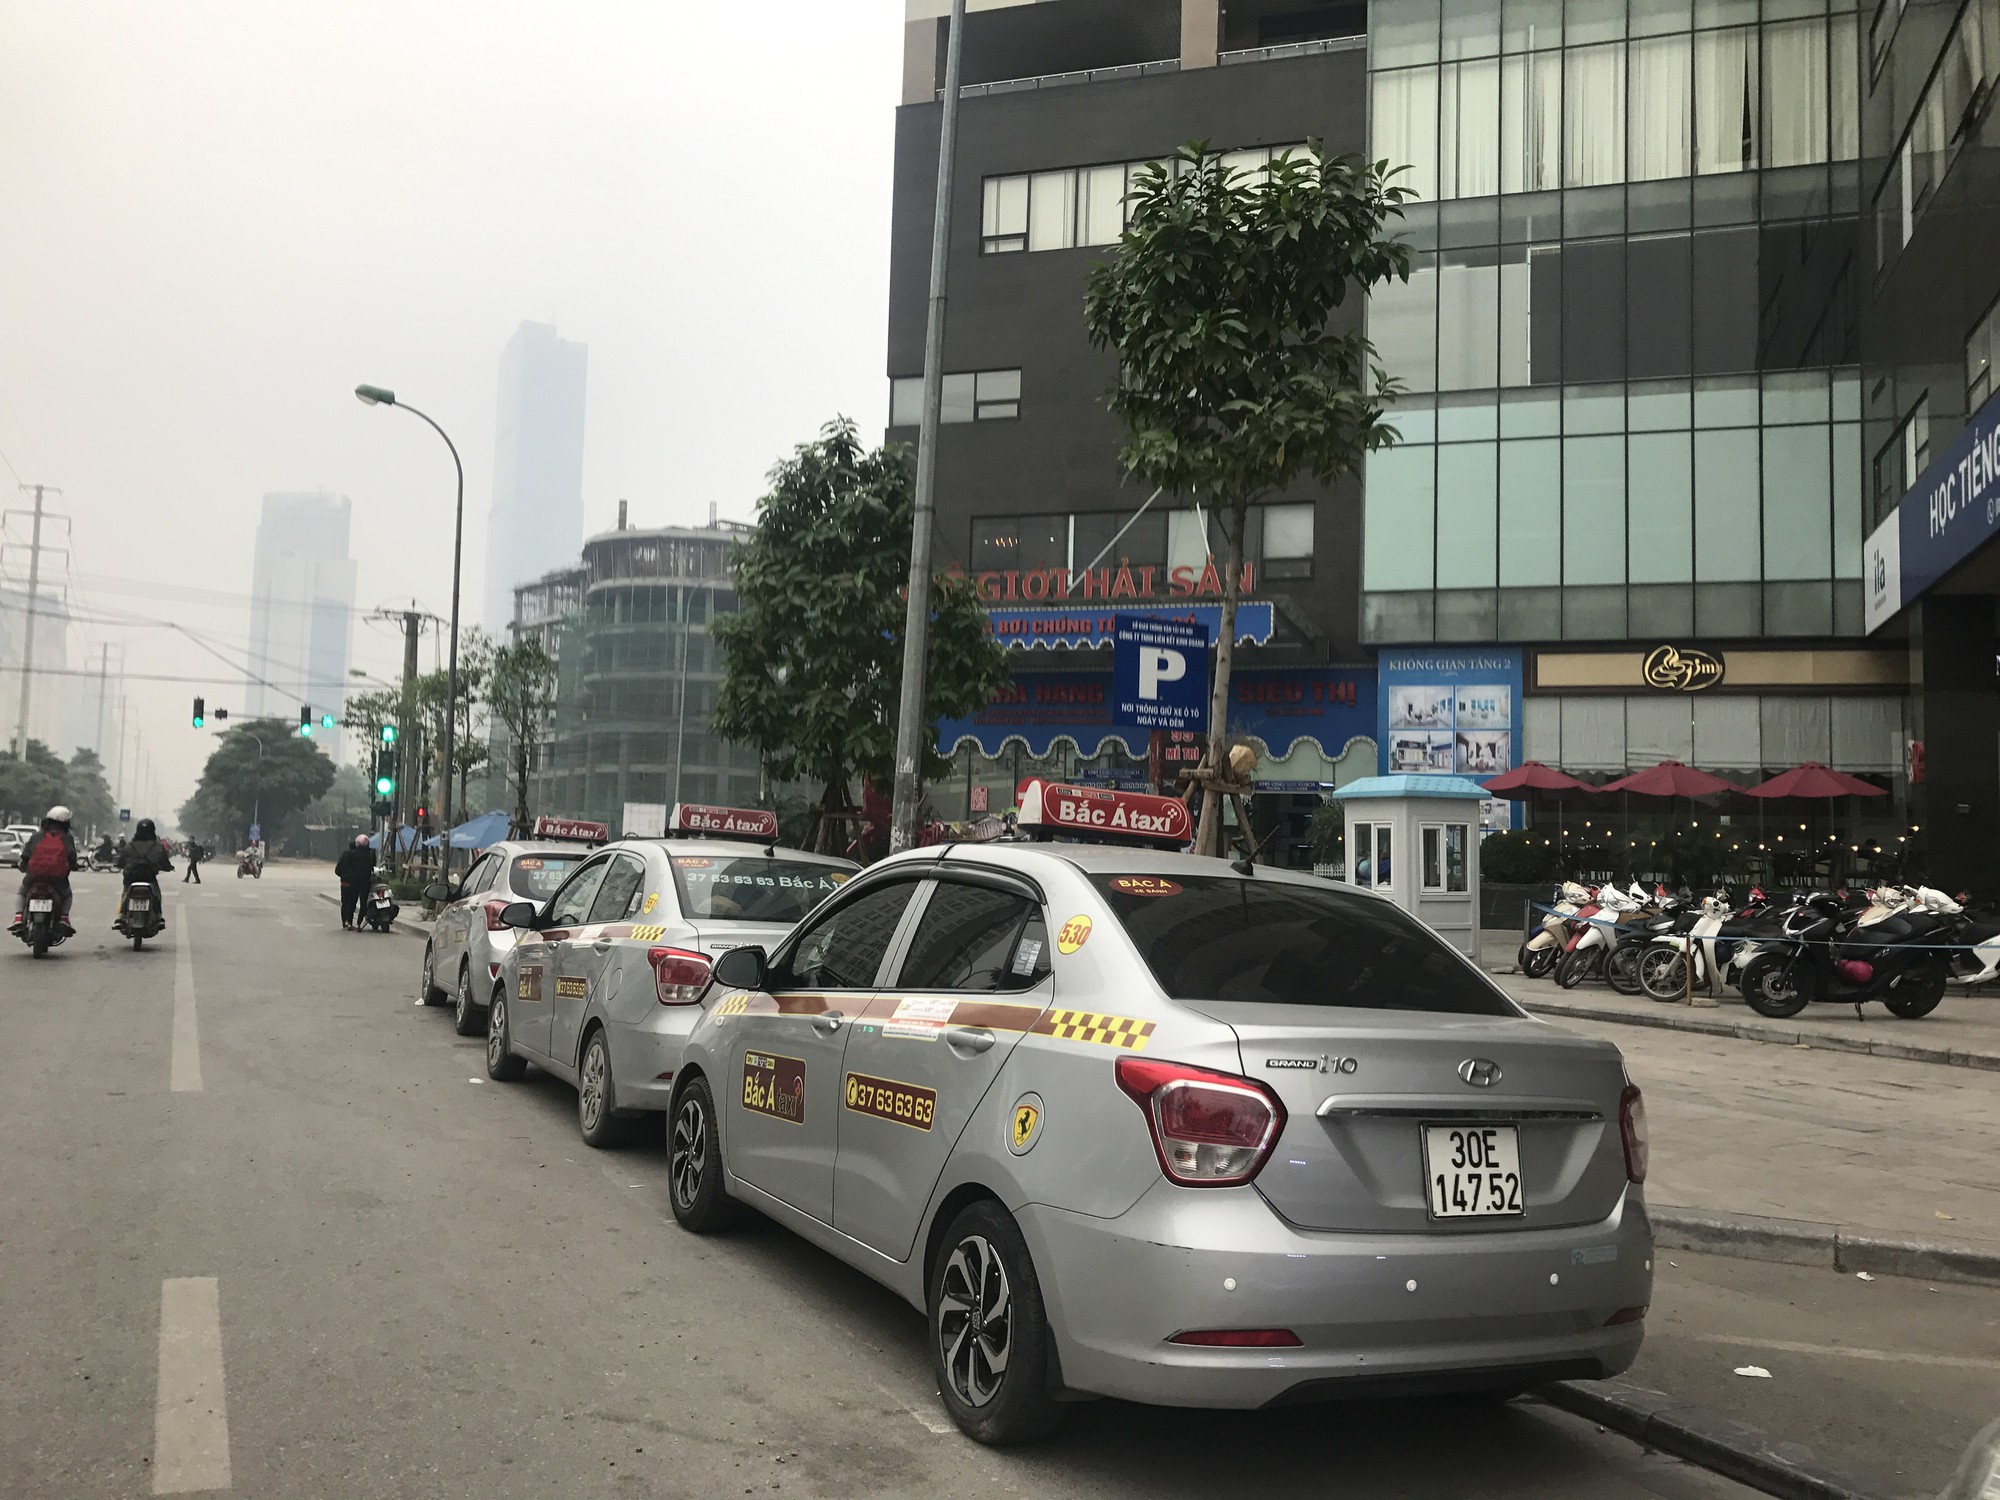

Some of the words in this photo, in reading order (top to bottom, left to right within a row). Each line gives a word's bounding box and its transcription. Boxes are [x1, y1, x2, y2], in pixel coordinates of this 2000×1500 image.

[1929, 472, 1956, 538] HỌC
[1083, 556, 1155, 599] HẢI
[1873, 548, 1886, 596] ila
[1032, 616, 1092, 634] CHÚNG
[1119, 629, 1133, 640] CÔNG
[1133, 632, 1139, 641] TY
[1138, 645, 1187, 700] P
[1389, 657, 1434, 671] KHÔNG
[1436, 658, 1466, 670] GIAN
[1121, 702, 1134, 713] NƠI
[1173, 708, 1182, 717] XE
[1183, 706, 1189, 718] Ô
[1190, 707, 1200, 718] TÔ
[1136, 715, 1156, 726] NGÀY
[1158, 716, 1167, 727] VÀ
[690, 814, 720, 828] Bắc
[1059, 800, 1105, 824] Bắc
[687, 873, 706, 881] 37
[711, 874, 729, 883] 63
[734, 876, 752, 885] 63
[756, 877, 775, 886] 63
[779, 875, 814, 888] Bắc
[1059, 924, 1091, 946] 530
[1269, 1060, 1315, 1068] GRAND
[1319, 1054, 1358, 1074] i10
[744, 1071, 765, 1107] Bắc
[766, 1075, 776, 1111] Á
[1450, 1130, 1499, 1168] 30E
[1436, 1173, 1520, 1212] 147.52
